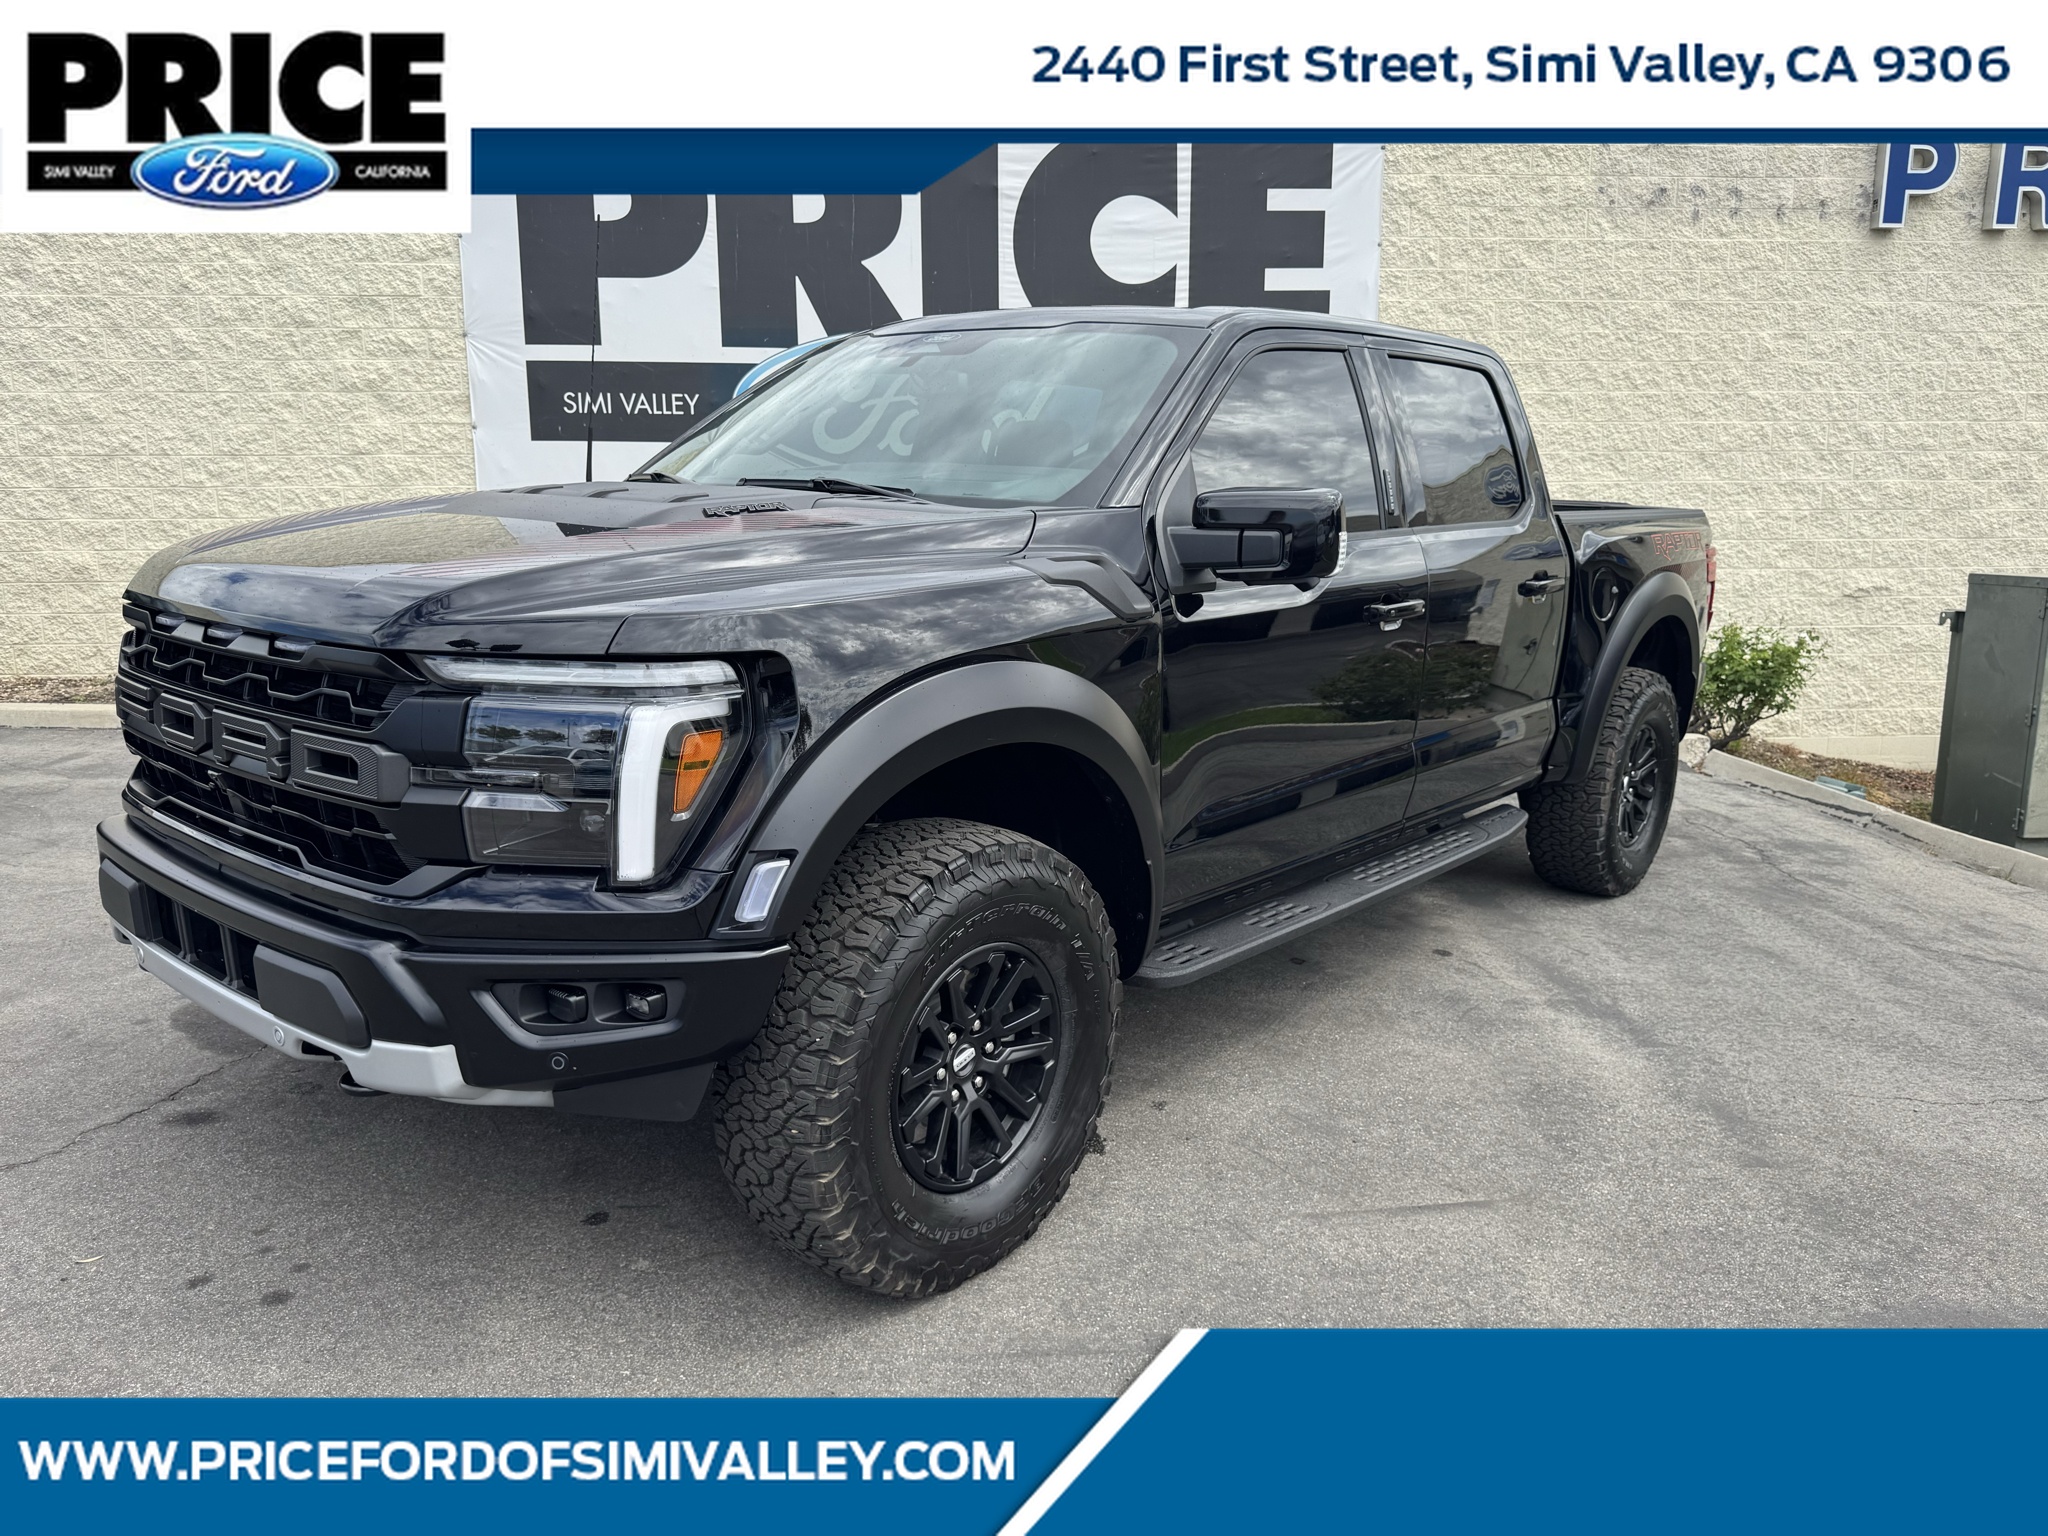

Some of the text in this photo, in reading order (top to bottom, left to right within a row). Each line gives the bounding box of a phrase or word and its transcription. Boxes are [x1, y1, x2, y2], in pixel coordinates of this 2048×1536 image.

[516, 143, 1334, 347] PRICE
[562, 391, 700, 416] SIMI VALLEY
[702, 502, 793, 518] RAPTOR
[116, 674, 409, 803] FORD
